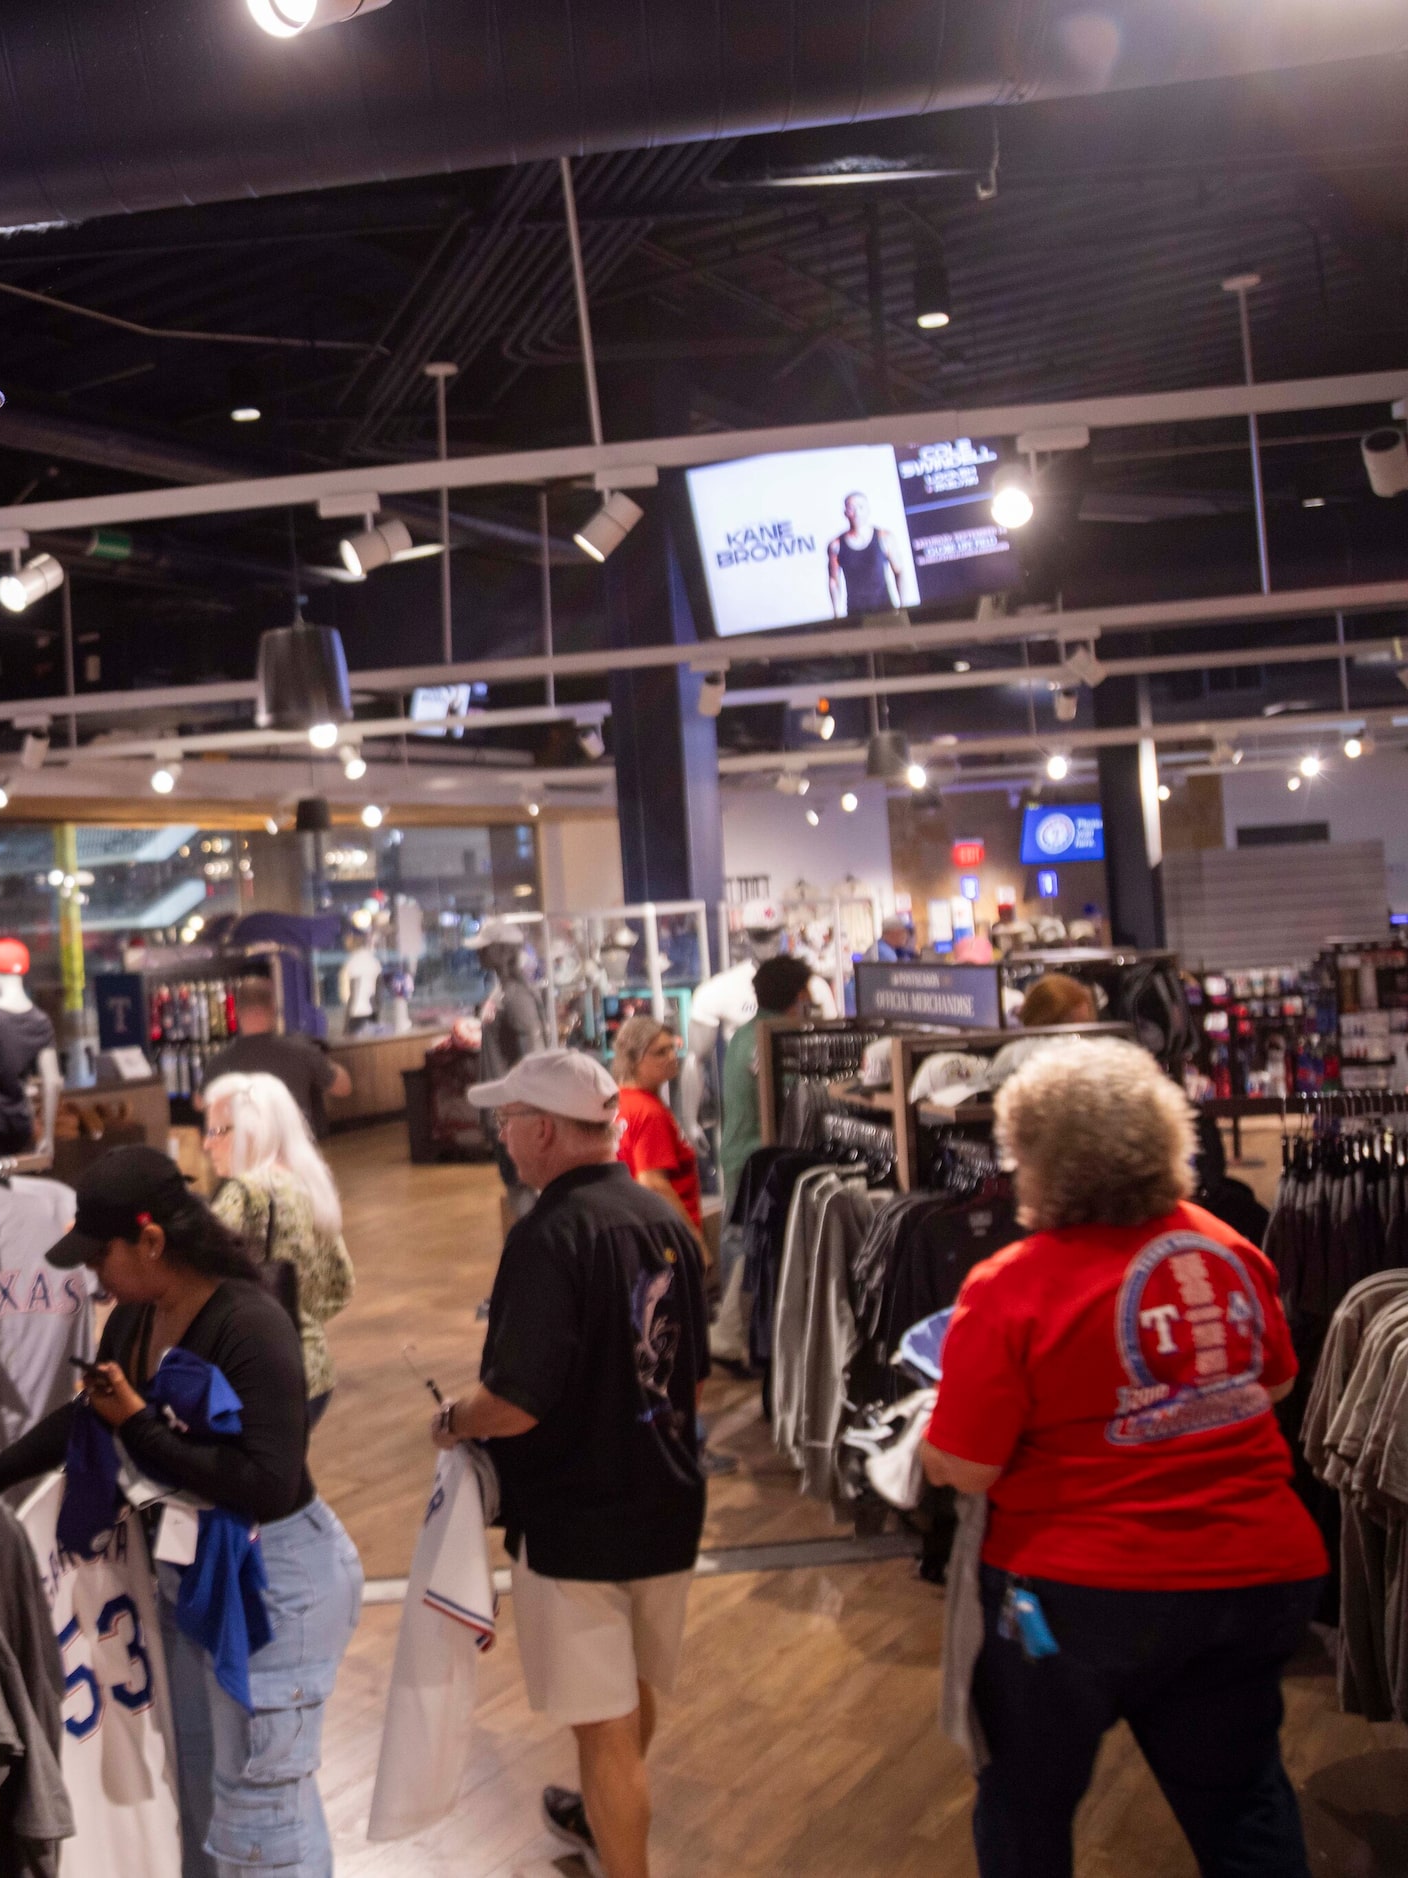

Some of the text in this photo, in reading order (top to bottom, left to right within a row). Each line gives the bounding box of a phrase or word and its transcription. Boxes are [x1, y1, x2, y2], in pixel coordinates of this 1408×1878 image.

[726, 520, 793, 548] KANE
[716, 536, 817, 568] BROWN
[876, 989, 975, 1018] OFFICIAL MERCHANDISE
[57, 1594, 155, 1743] 53
